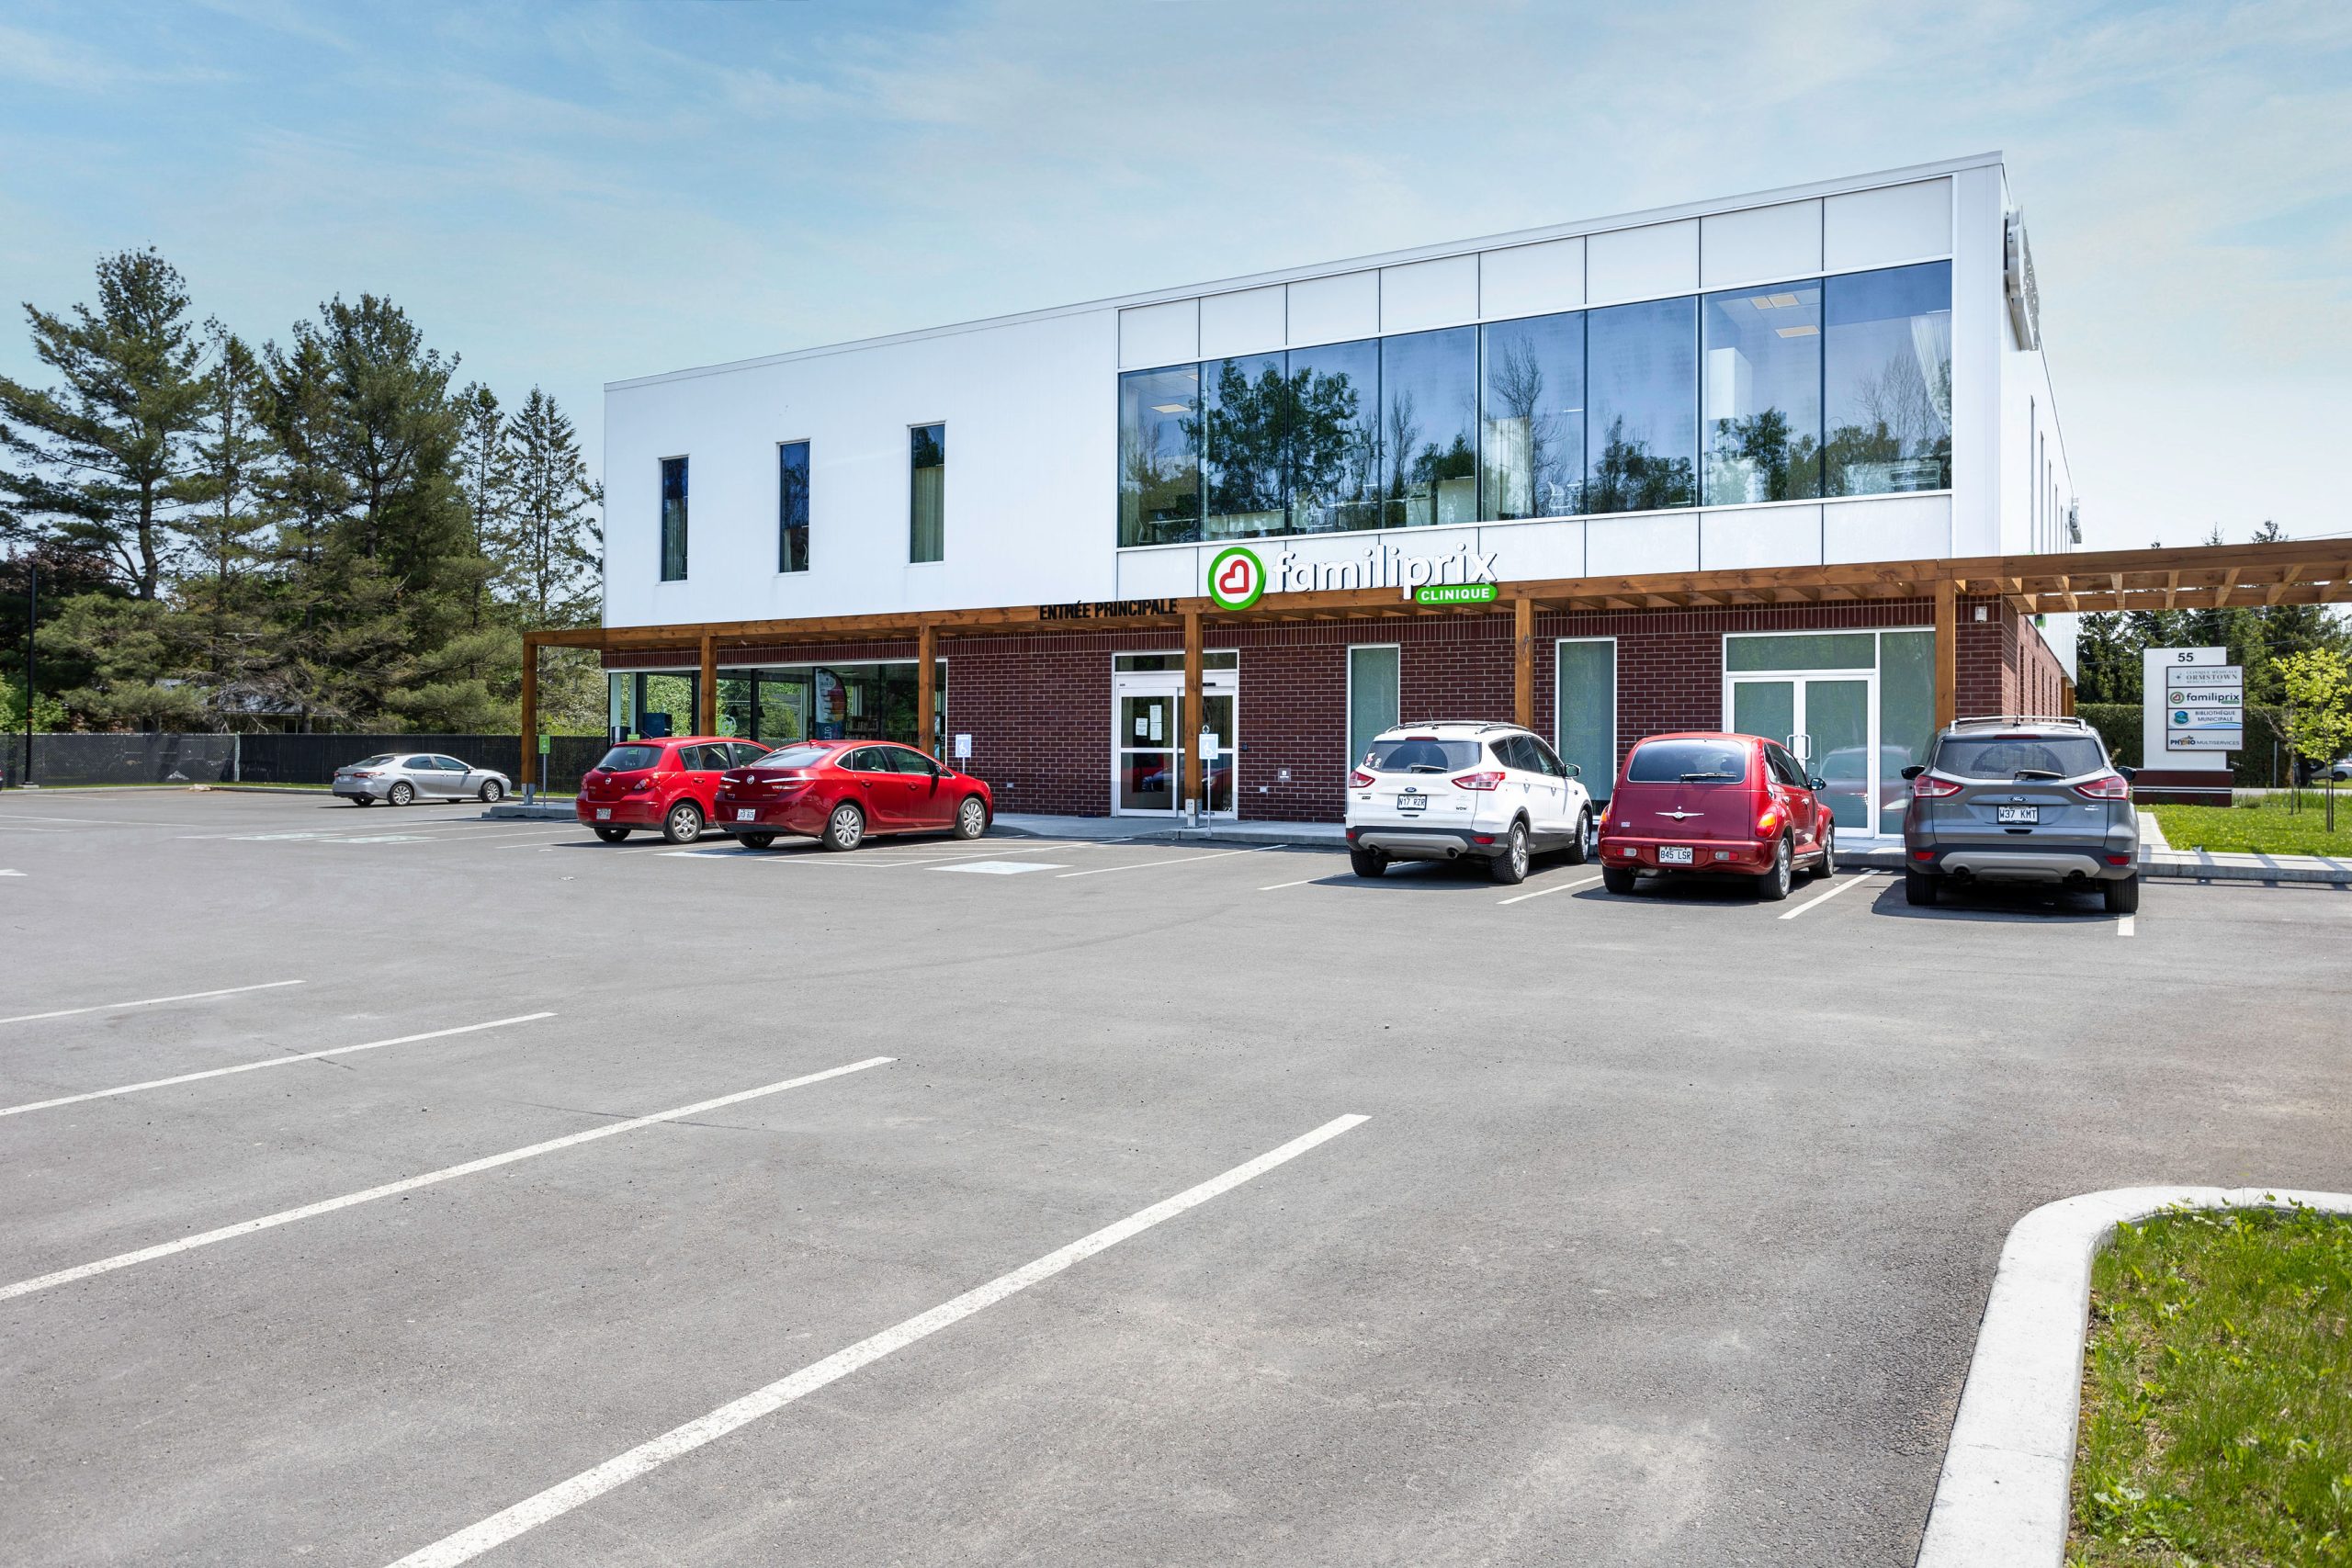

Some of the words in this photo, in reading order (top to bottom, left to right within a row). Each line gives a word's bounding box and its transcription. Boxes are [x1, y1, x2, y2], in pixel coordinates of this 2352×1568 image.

[1272, 542, 1498, 600] familiprix
[1420, 585, 1490, 602] CLINIQUE
[1039, 601, 1091, 621] ENTRÉE
[1094, 598, 1178, 618] PRINCIPALE
[2177, 652, 2194, 662] 55
[2187, 693, 2239, 703] familiprix
[1999, 809, 2015, 818] W37
[2021, 809, 2036, 818] KMT
[1678, 852, 1690, 860] LSR
